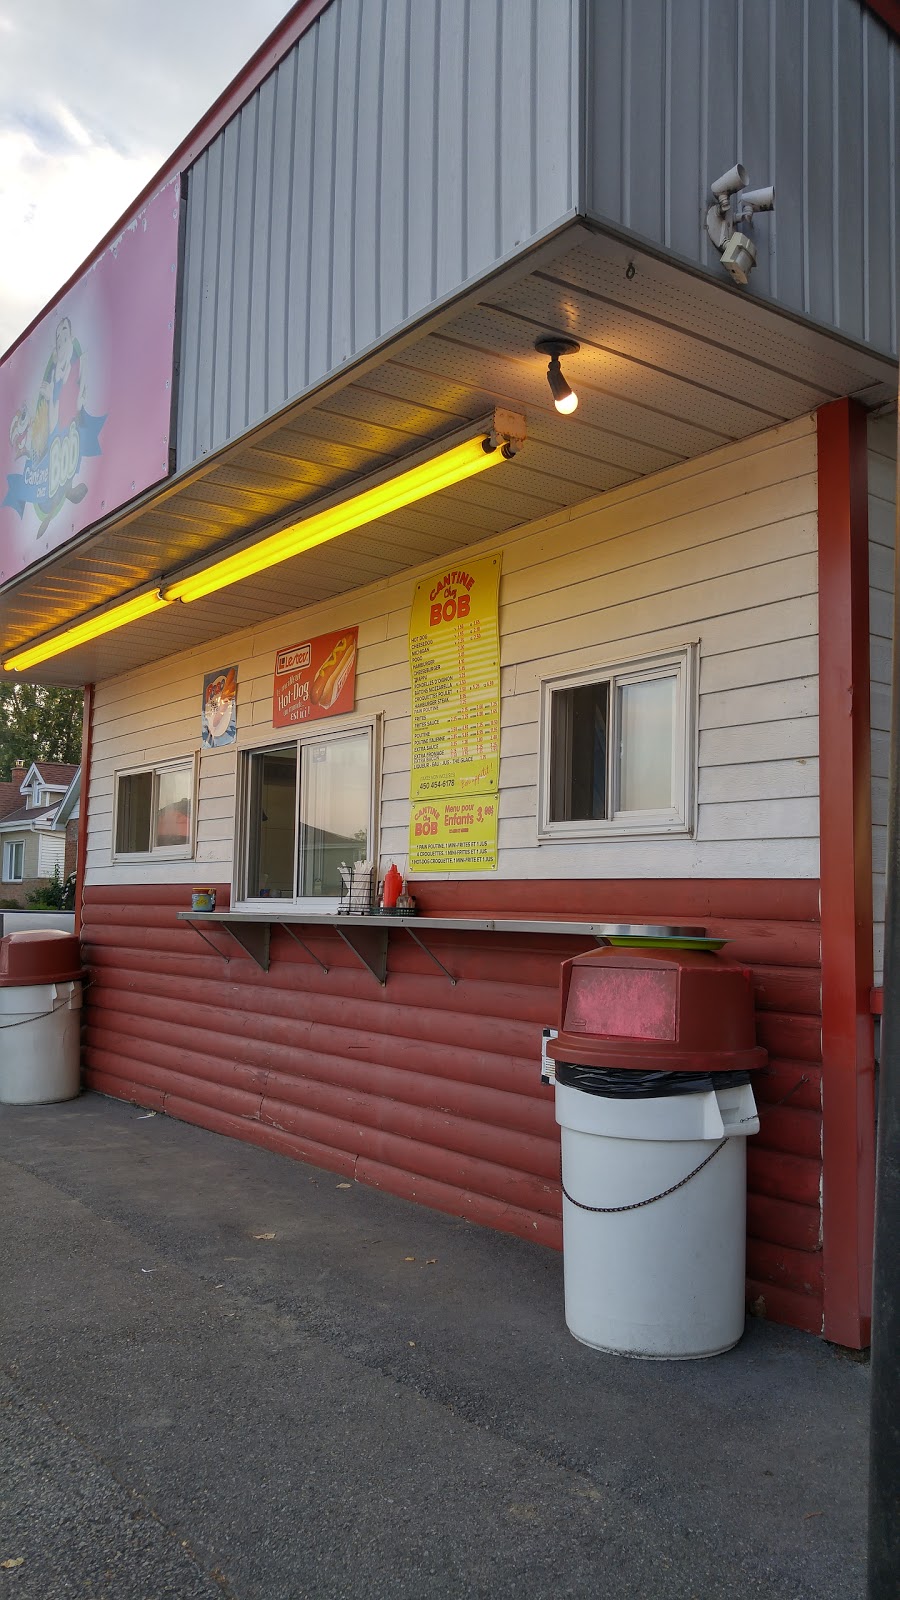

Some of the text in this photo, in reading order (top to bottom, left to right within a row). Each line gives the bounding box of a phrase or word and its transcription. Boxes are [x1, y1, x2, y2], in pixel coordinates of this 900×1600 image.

[24, 467, 48, 484] Cantine
[430, 571, 475, 601] CANTINE
[430, 594, 470, 626] BOB
[278, 682, 309, 711] Hot-Dog
[431, 780, 454, 788] 454-6178
[414, 806, 440, 820] CANTINE
[461, 804, 474, 813] pour
[444, 813, 474, 826] Enfants
[415, 822, 438, 836] BOB
